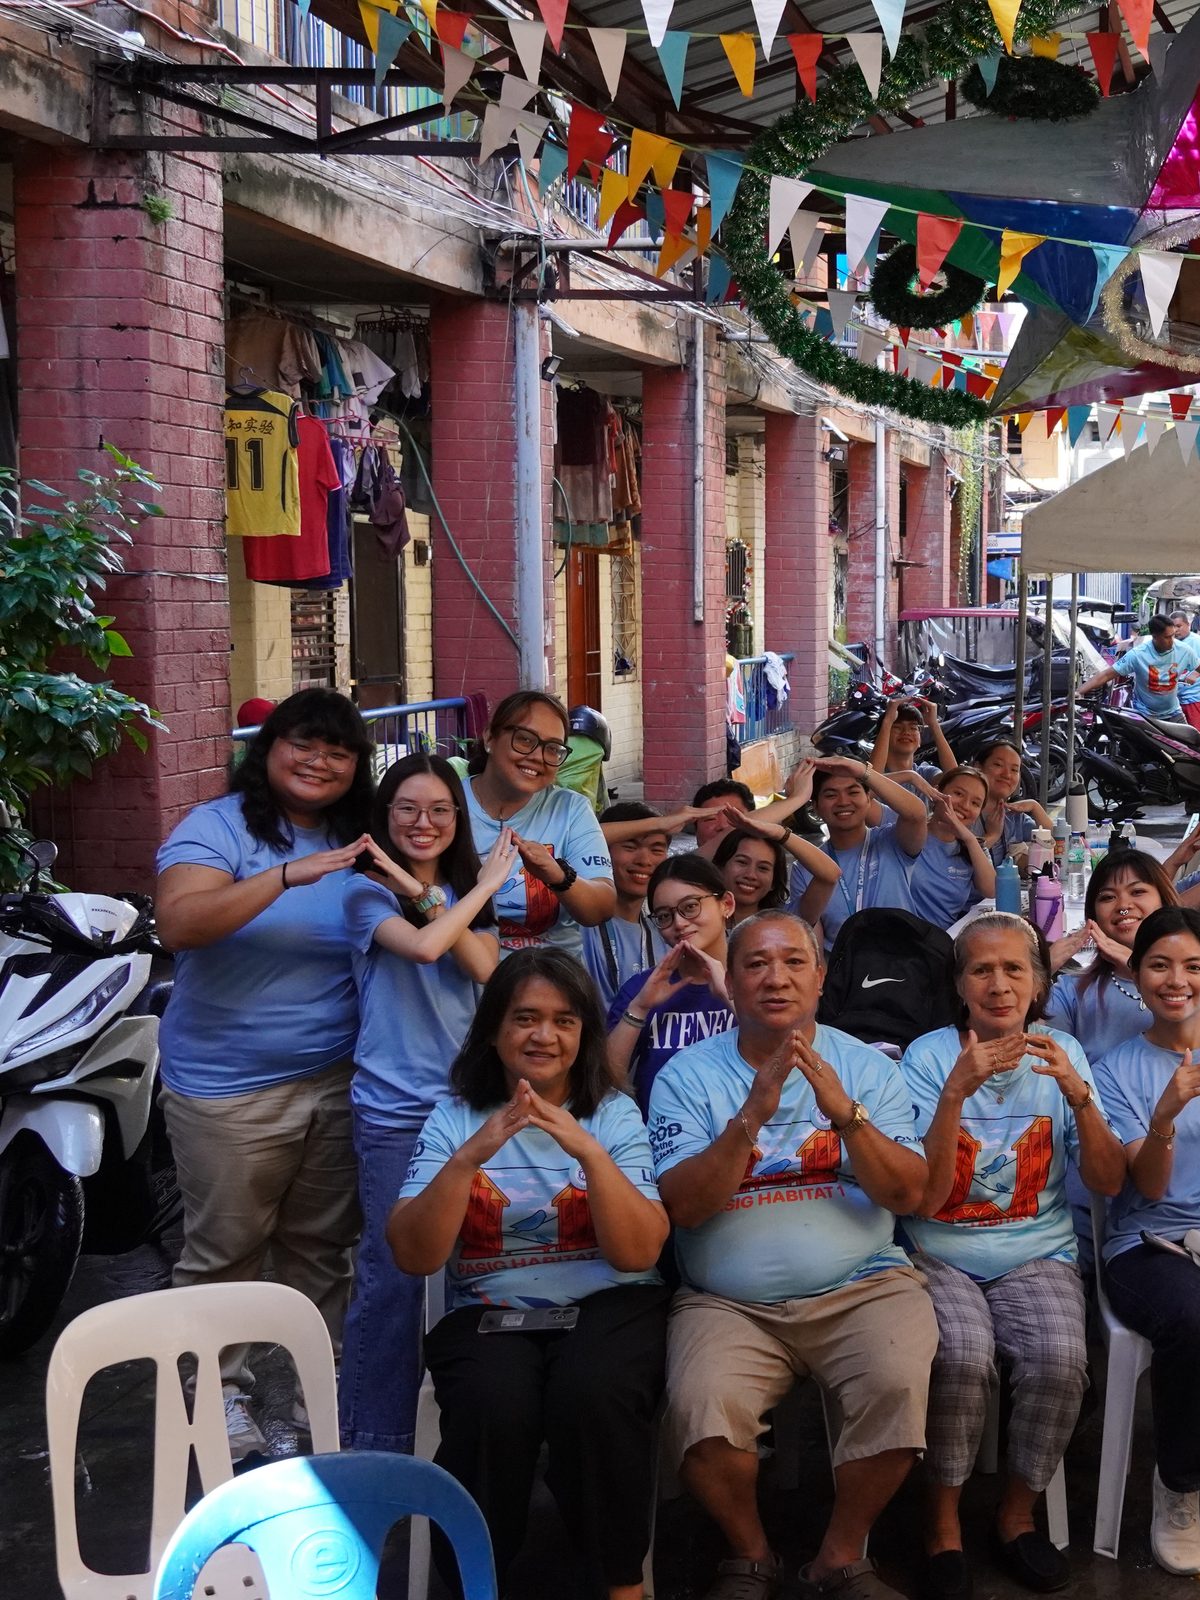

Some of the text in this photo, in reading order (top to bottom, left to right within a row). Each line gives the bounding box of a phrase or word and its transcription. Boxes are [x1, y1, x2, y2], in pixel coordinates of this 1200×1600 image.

[225, 437, 264, 491] 11
[719, 1184, 846, 1213] SIG HABITAT 1
[456, 1258, 509, 1276] PASIG
